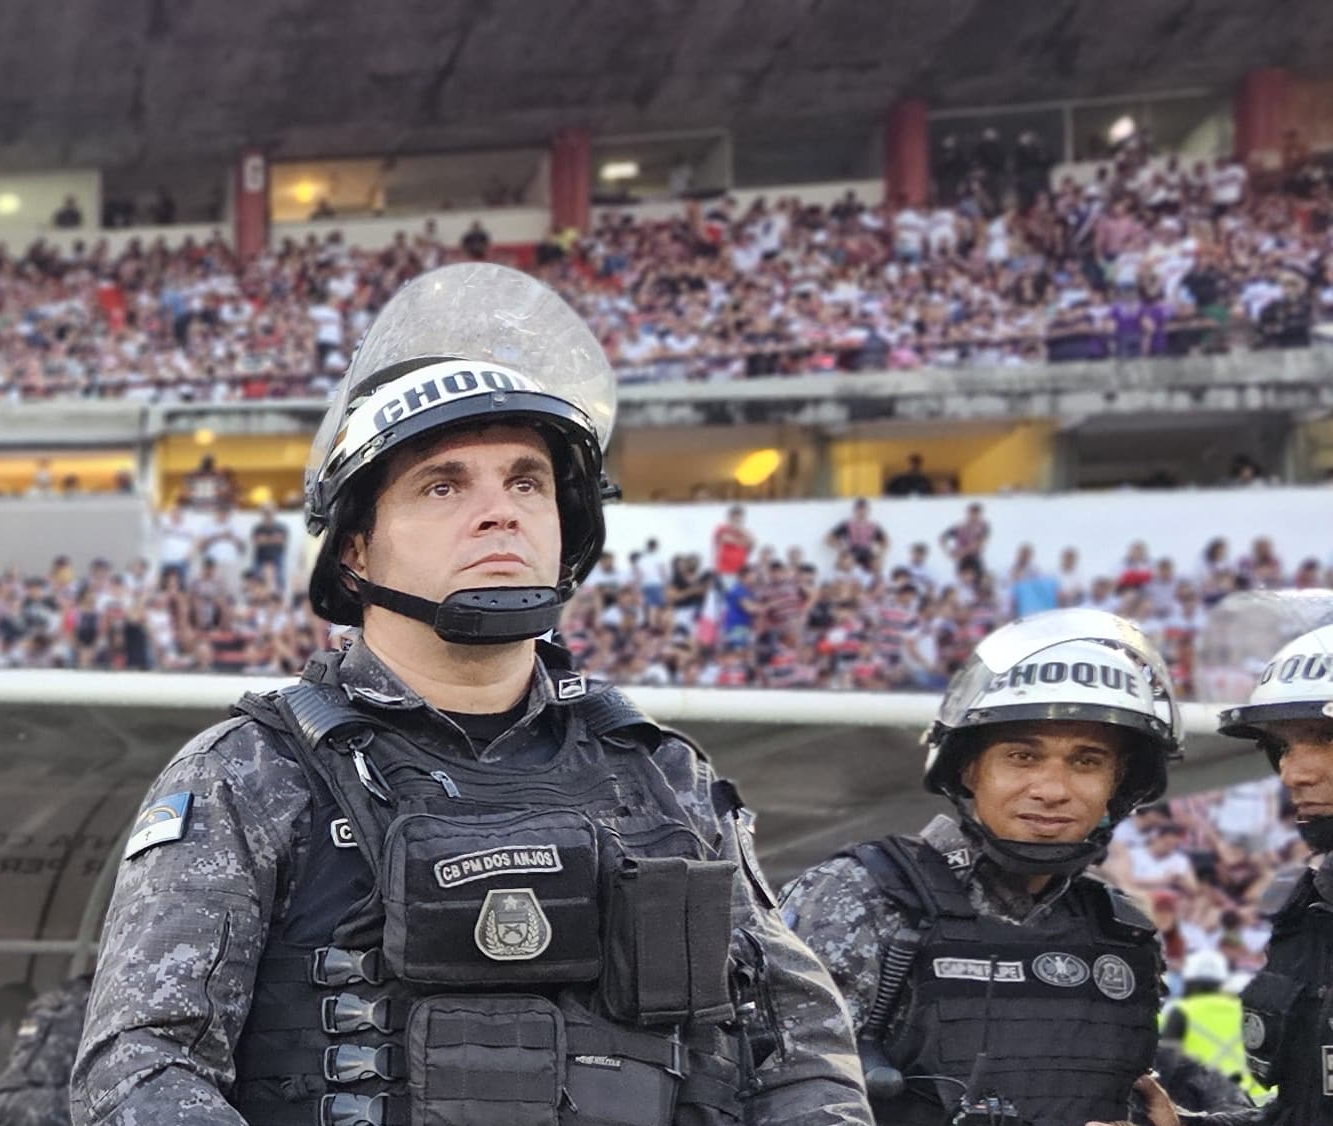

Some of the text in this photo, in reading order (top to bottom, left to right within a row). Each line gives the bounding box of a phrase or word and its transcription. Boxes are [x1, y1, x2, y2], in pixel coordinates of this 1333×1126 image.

[986, 661, 1141, 697] CHOQUE
[442, 851, 553, 880] CB PM DOS ANJOS
